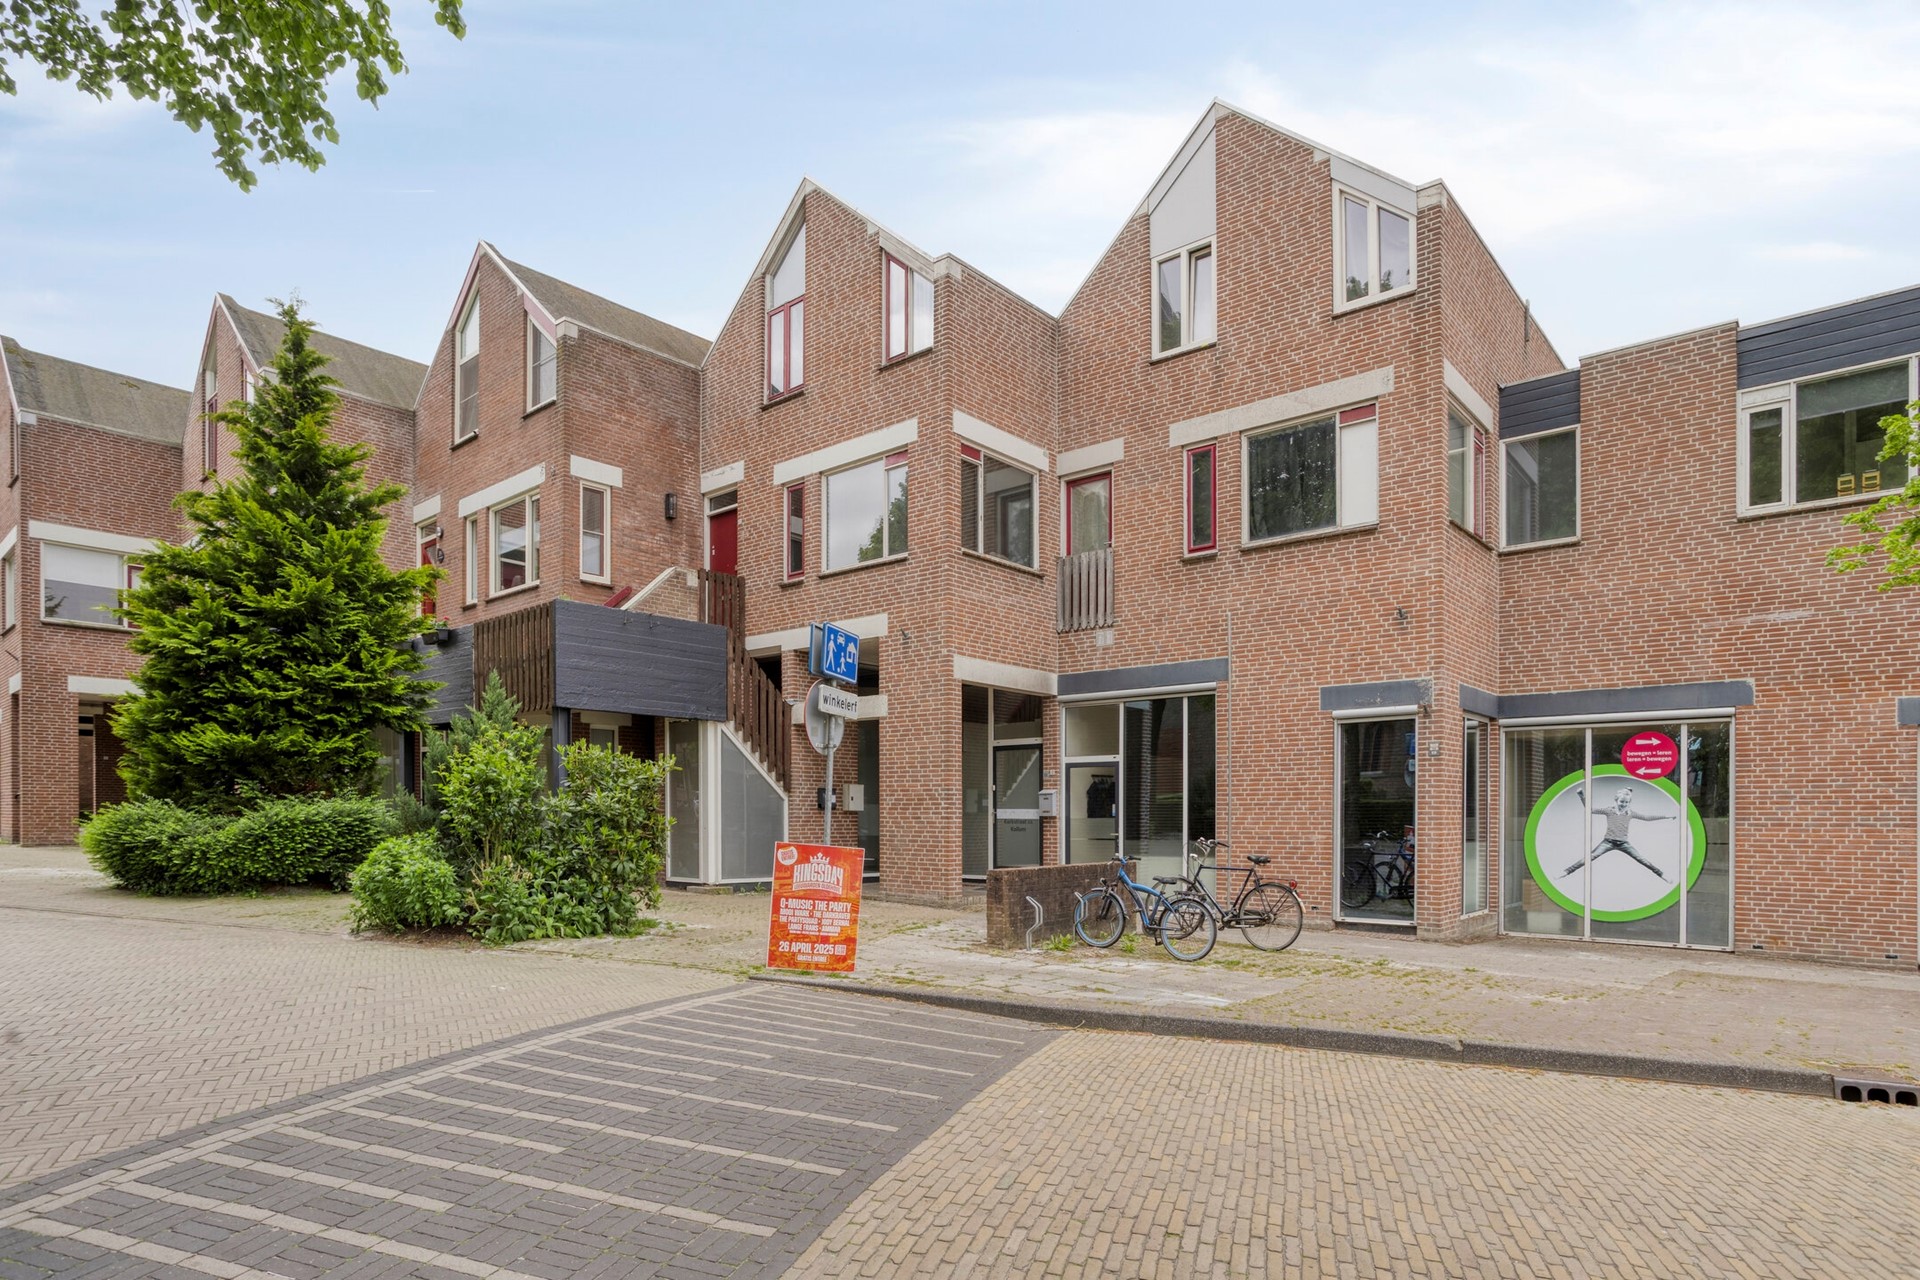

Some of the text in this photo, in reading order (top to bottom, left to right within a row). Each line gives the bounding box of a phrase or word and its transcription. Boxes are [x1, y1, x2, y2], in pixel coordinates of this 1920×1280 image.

[823, 693, 858, 713] winkelerf
[793, 863, 844, 886] KINGSDAY
[814, 900, 828, 911] THE
[829, 901, 852, 913] PARTY
[779, 915, 787, 923] THE
[813, 910, 822, 918] THE
[779, 941, 789, 952] 26
[790, 942, 813, 953] APRIL
[813, 943, 835, 955] 2025
